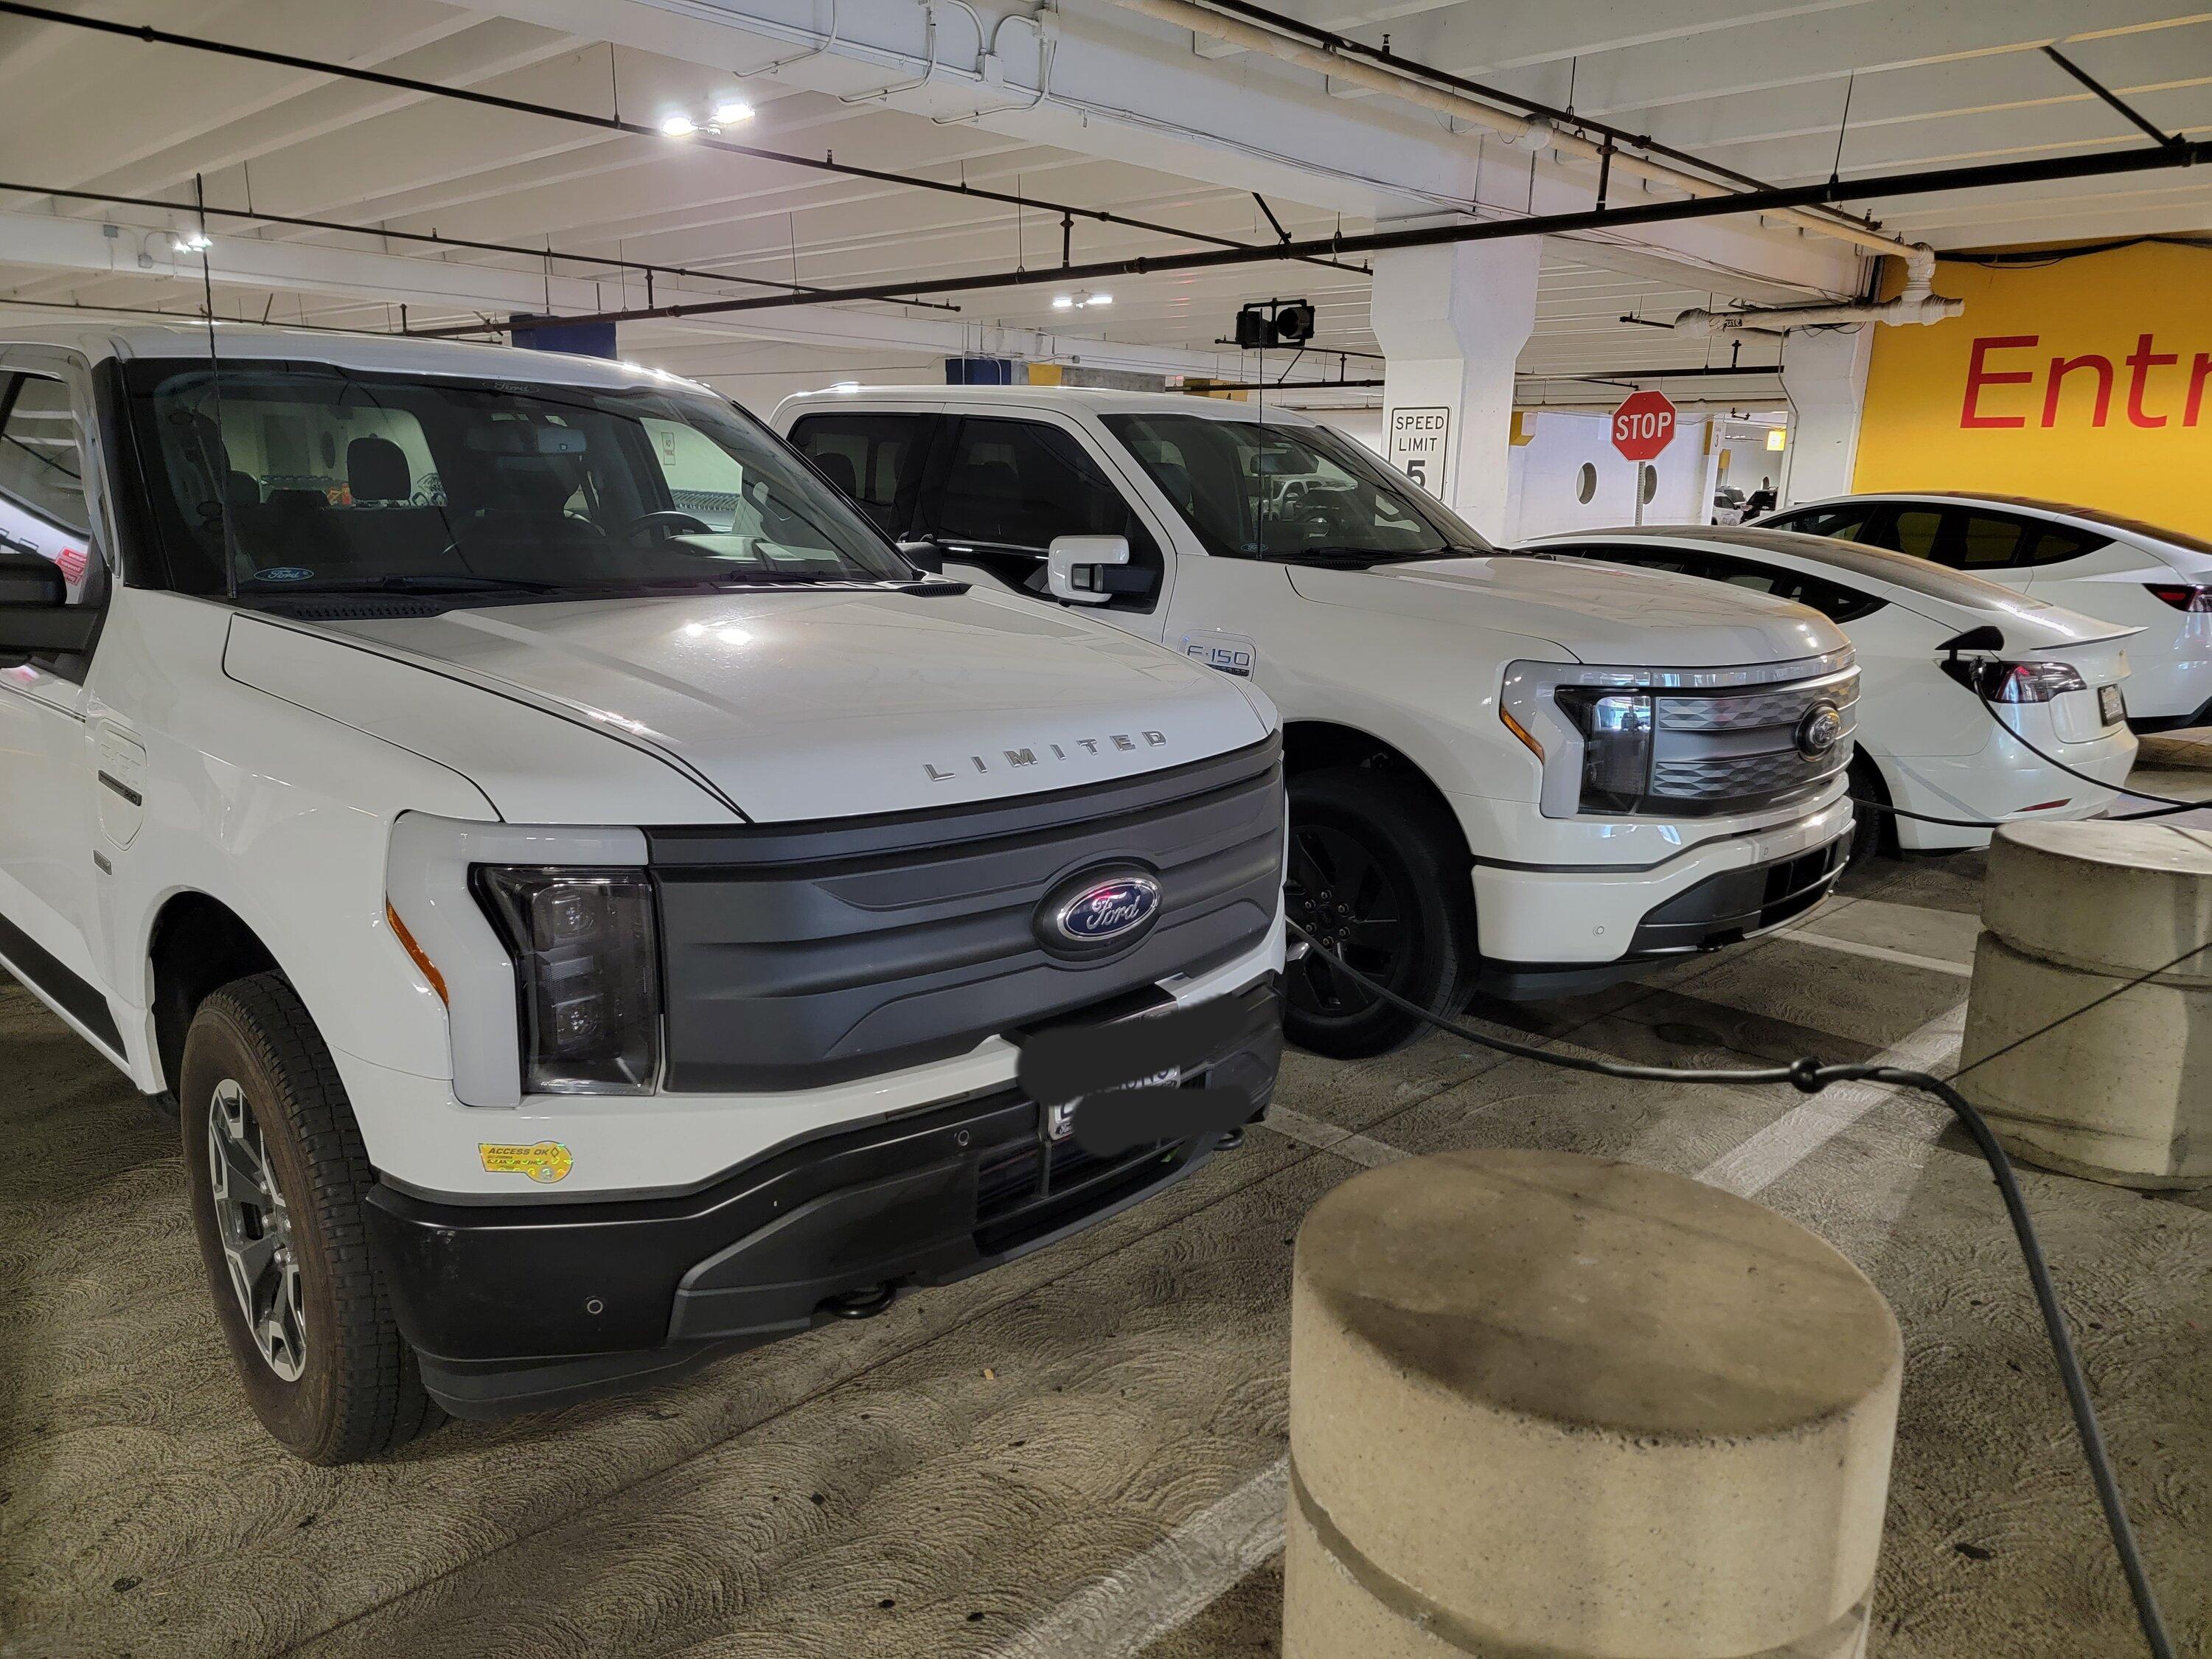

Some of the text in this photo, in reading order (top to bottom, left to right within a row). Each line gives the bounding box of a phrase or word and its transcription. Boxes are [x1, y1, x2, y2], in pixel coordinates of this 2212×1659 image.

[1960, 333, 2212, 428] Entr
[1396, 416, 1444, 430] SPEED
[1615, 411, 1672, 441] STOP
[1399, 437, 1438, 451] LIMIT
[1407, 459, 1426, 487] 5
[268, 569, 299, 579] Ford
[1187, 644, 1250, 667] F-150
[922, 730, 1166, 782] LIMITED
[1086, 891, 1140, 930] Ford
[488, 1147, 530, 1155] ACCESS
